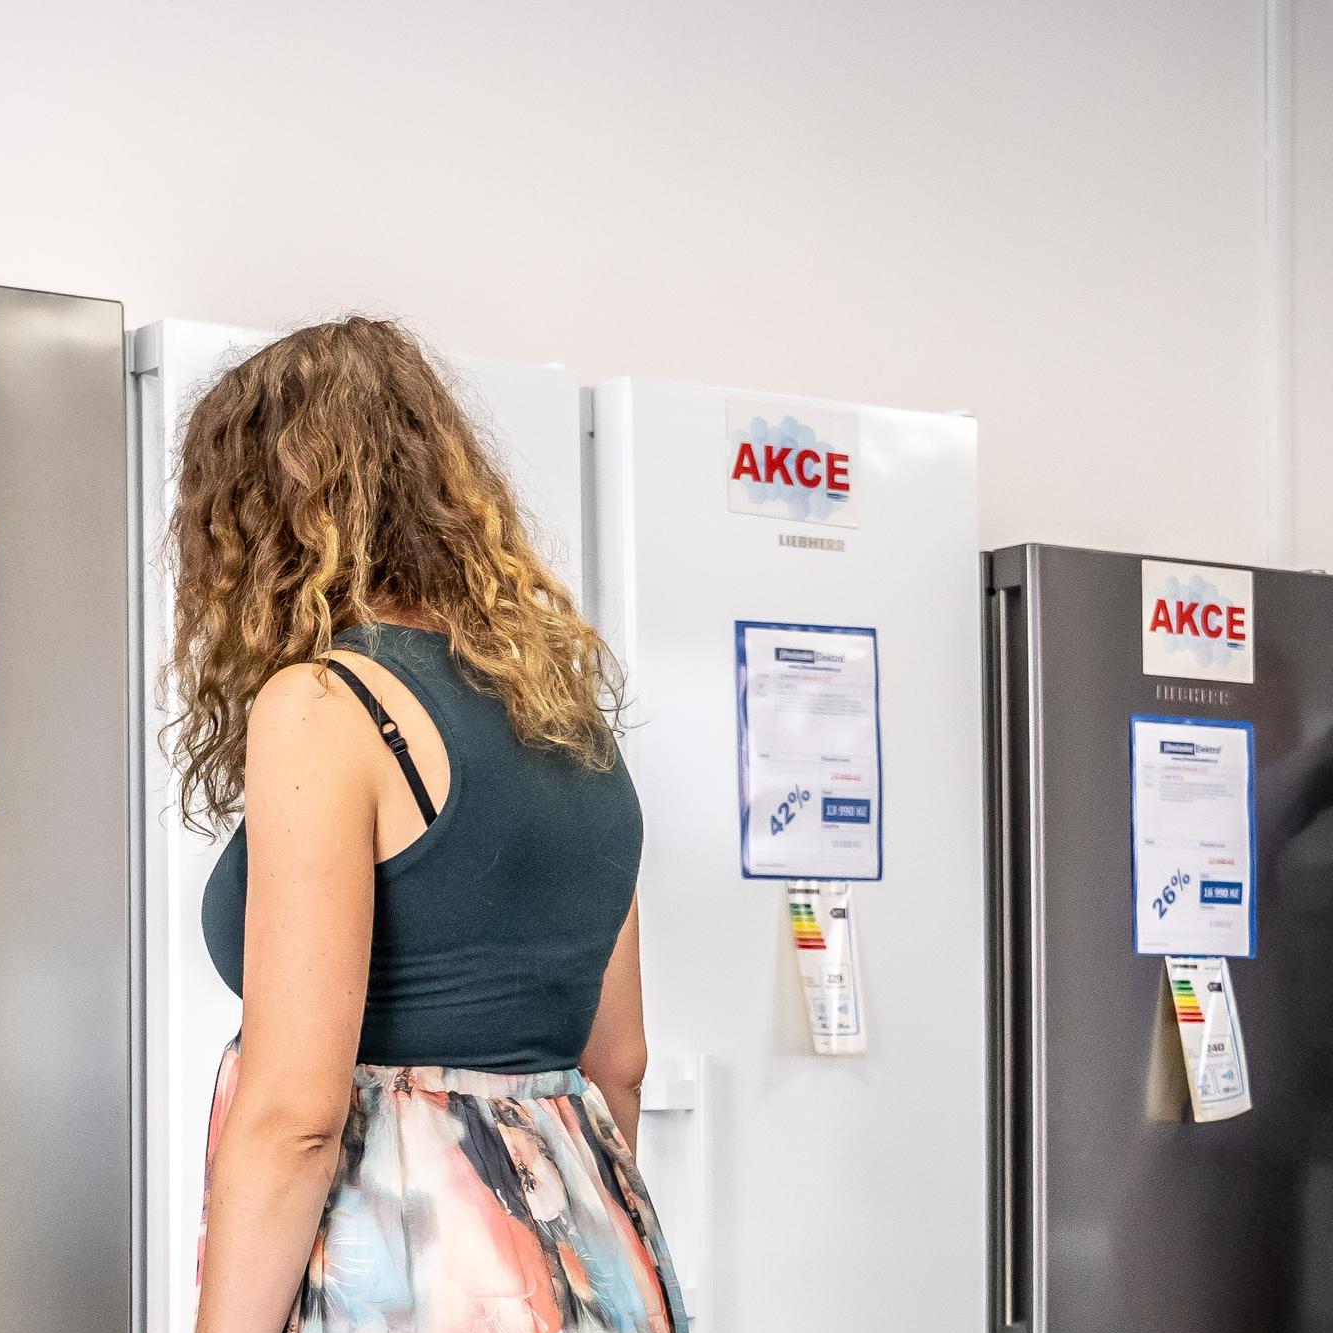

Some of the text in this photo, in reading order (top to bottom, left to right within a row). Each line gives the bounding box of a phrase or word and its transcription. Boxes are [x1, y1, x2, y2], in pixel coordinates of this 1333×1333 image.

[731, 443, 850, 491] AKCE
[1149, 598, 1245, 641] AKCE
[770, 784, 810, 836] 42%
[1152, 867, 1190, 920] 26%
